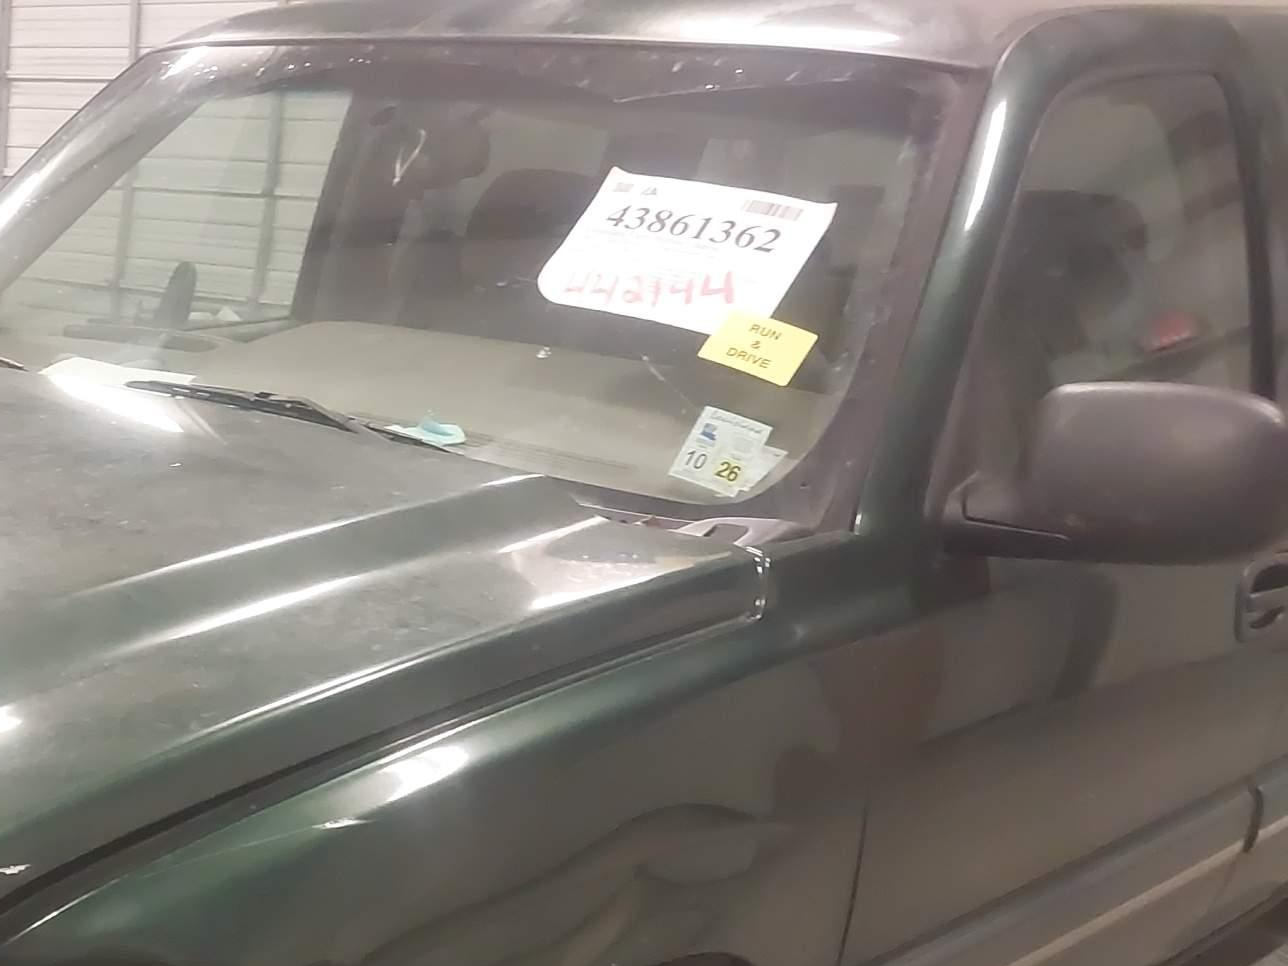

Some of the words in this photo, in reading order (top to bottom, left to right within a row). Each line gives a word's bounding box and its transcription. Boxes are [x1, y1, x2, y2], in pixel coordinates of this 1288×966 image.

[606, 204, 782, 253] 43861362
[747, 323, 783, 342] RUN
[750, 339, 763, 350] &
[725, 346, 771, 370] DRIVE
[684, 450, 708, 470] 10
[715, 461, 741, 482] 26
